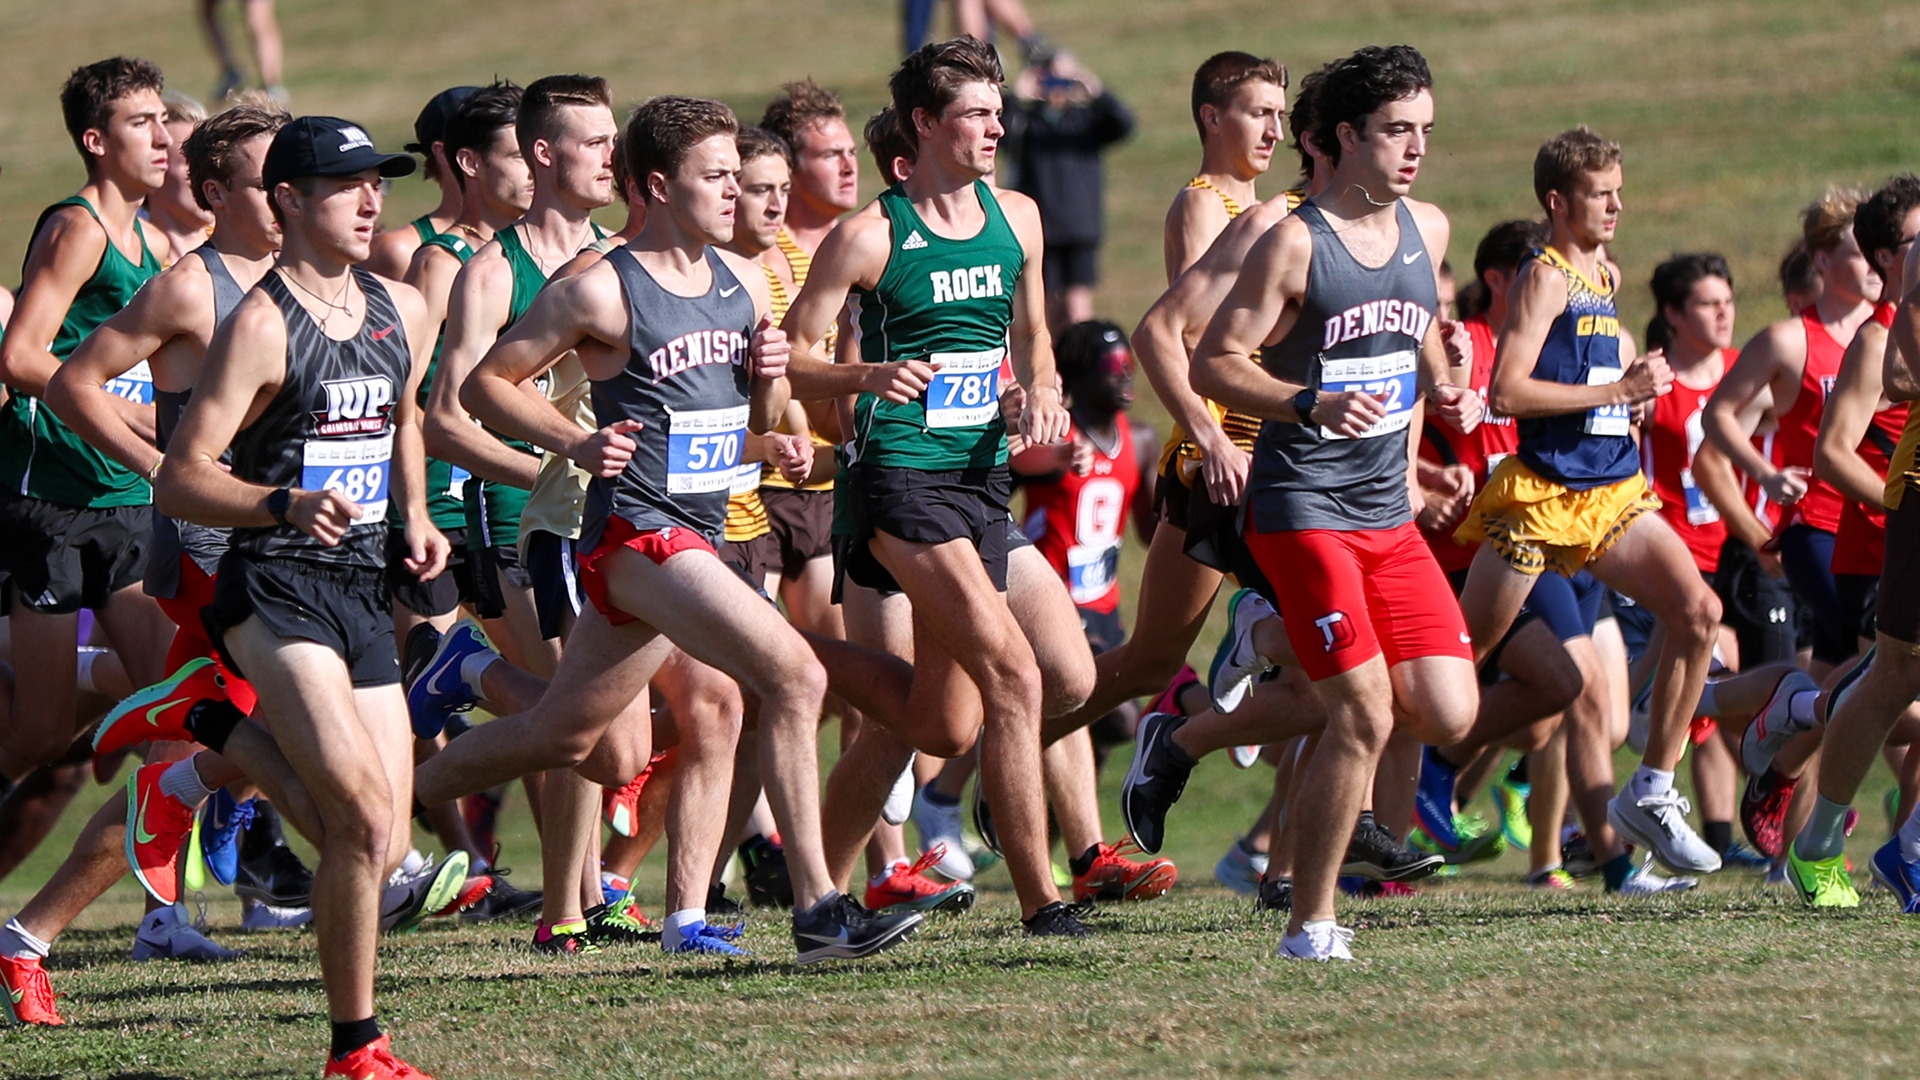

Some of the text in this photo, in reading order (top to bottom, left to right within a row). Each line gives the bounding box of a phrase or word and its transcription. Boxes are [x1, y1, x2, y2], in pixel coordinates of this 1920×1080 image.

[901, 239, 928, 250] adidas
[930, 264, 1003, 304] ROCK
[1322, 299, 1431, 351] DENISON
[326, 379, 391, 422] IUP
[943, 373, 992, 406] 781
[687, 433, 738, 470] 570
[322, 465, 383, 502] 689
[1075, 477, 1125, 547] G
